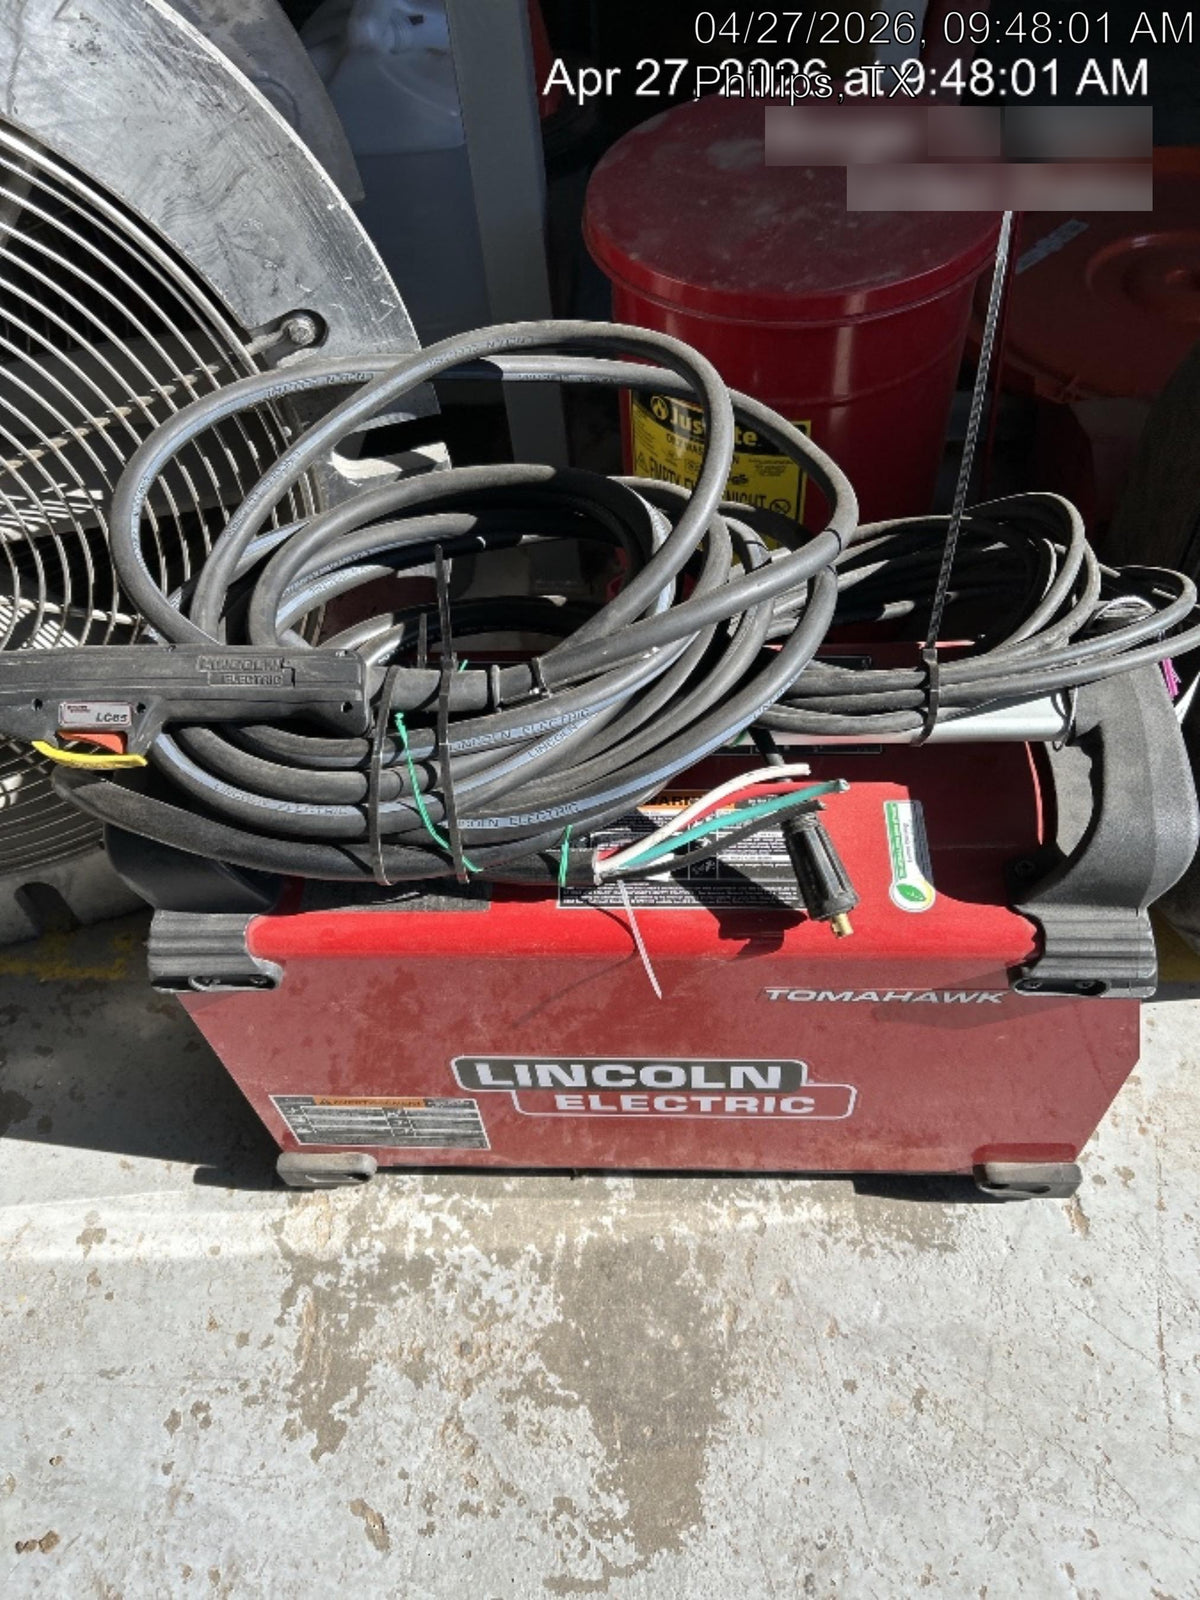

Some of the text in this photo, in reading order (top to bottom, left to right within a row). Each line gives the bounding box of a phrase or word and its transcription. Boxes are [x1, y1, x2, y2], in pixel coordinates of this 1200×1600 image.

[764, 988, 1007, 1005] TOMAHAWK
[475, 1062, 783, 1092] LINCOLN
[555, 1093, 816, 1115] ELECTRIC
